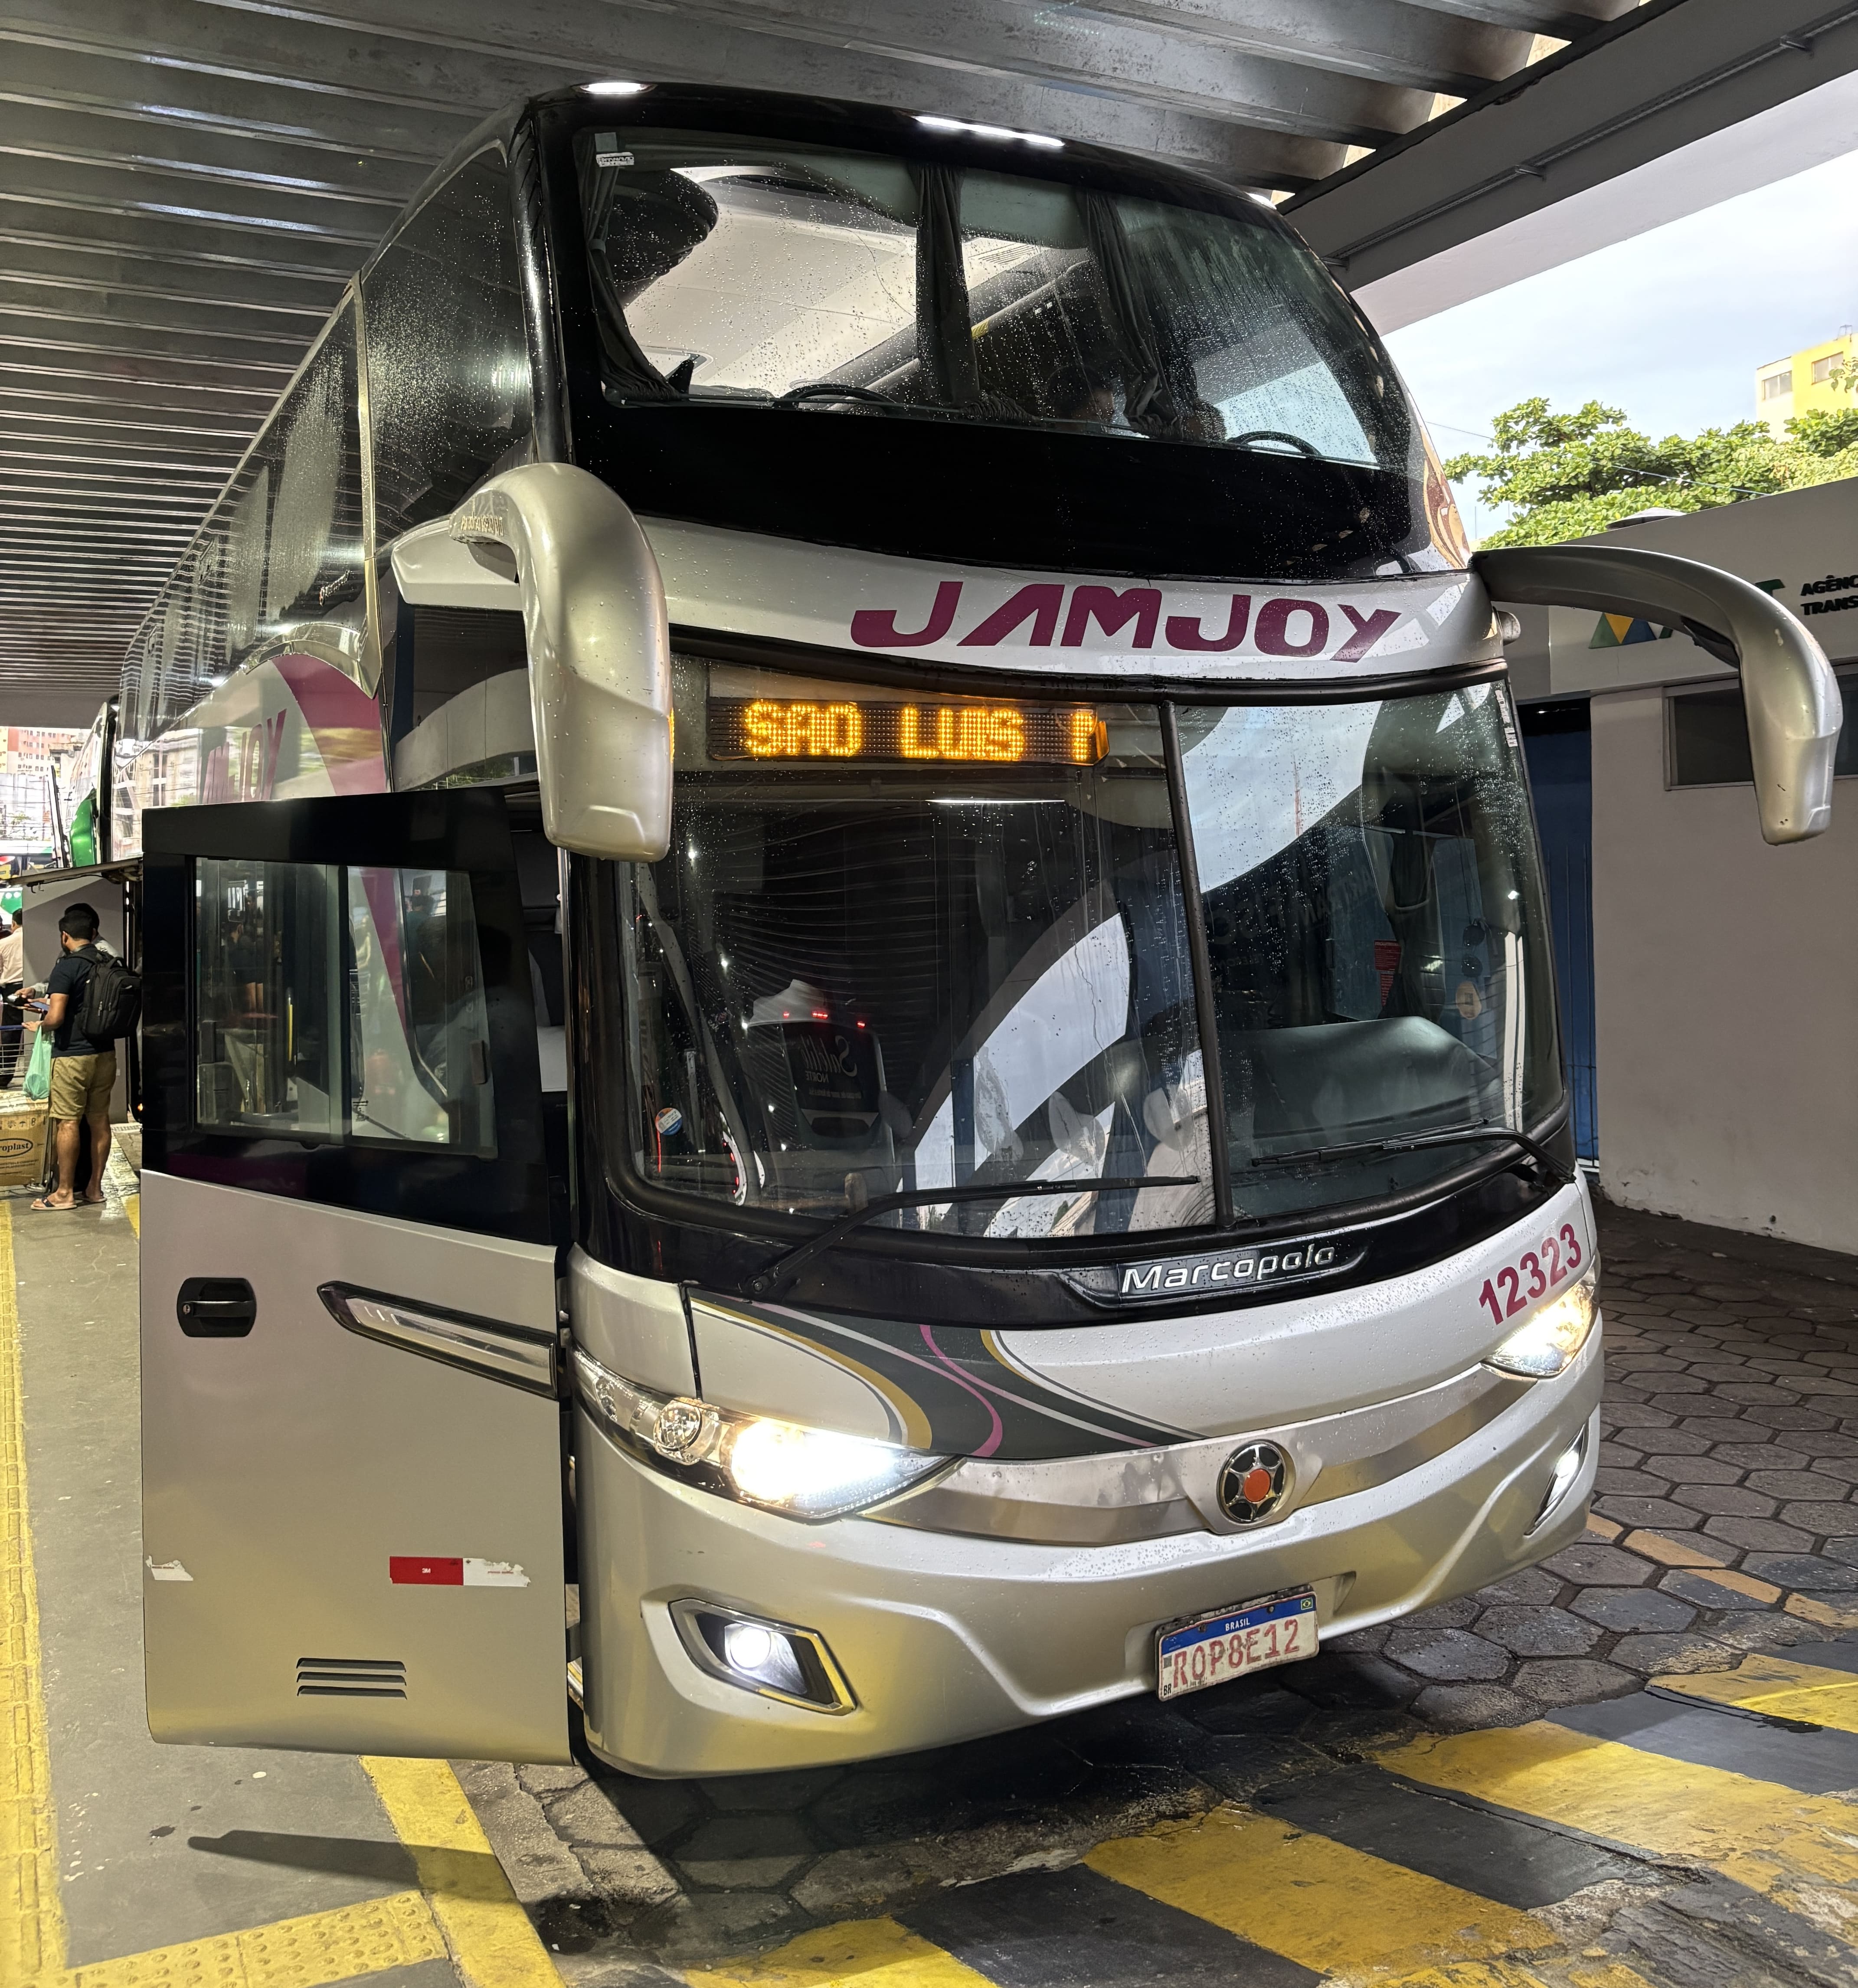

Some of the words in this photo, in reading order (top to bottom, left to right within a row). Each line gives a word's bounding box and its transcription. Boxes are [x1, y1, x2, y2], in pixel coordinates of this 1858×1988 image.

[850, 580, 1402, 663] JAMJOY
[1122, 1243, 1335, 1293] Marcopolo
[1479, 1223, 1581, 1325] 12323
[1173, 1619, 1300, 1688] ROP8E12
[1225, 1618, 1250, 1631] BRASIL
[1163, 1683, 1171, 1696] BR
